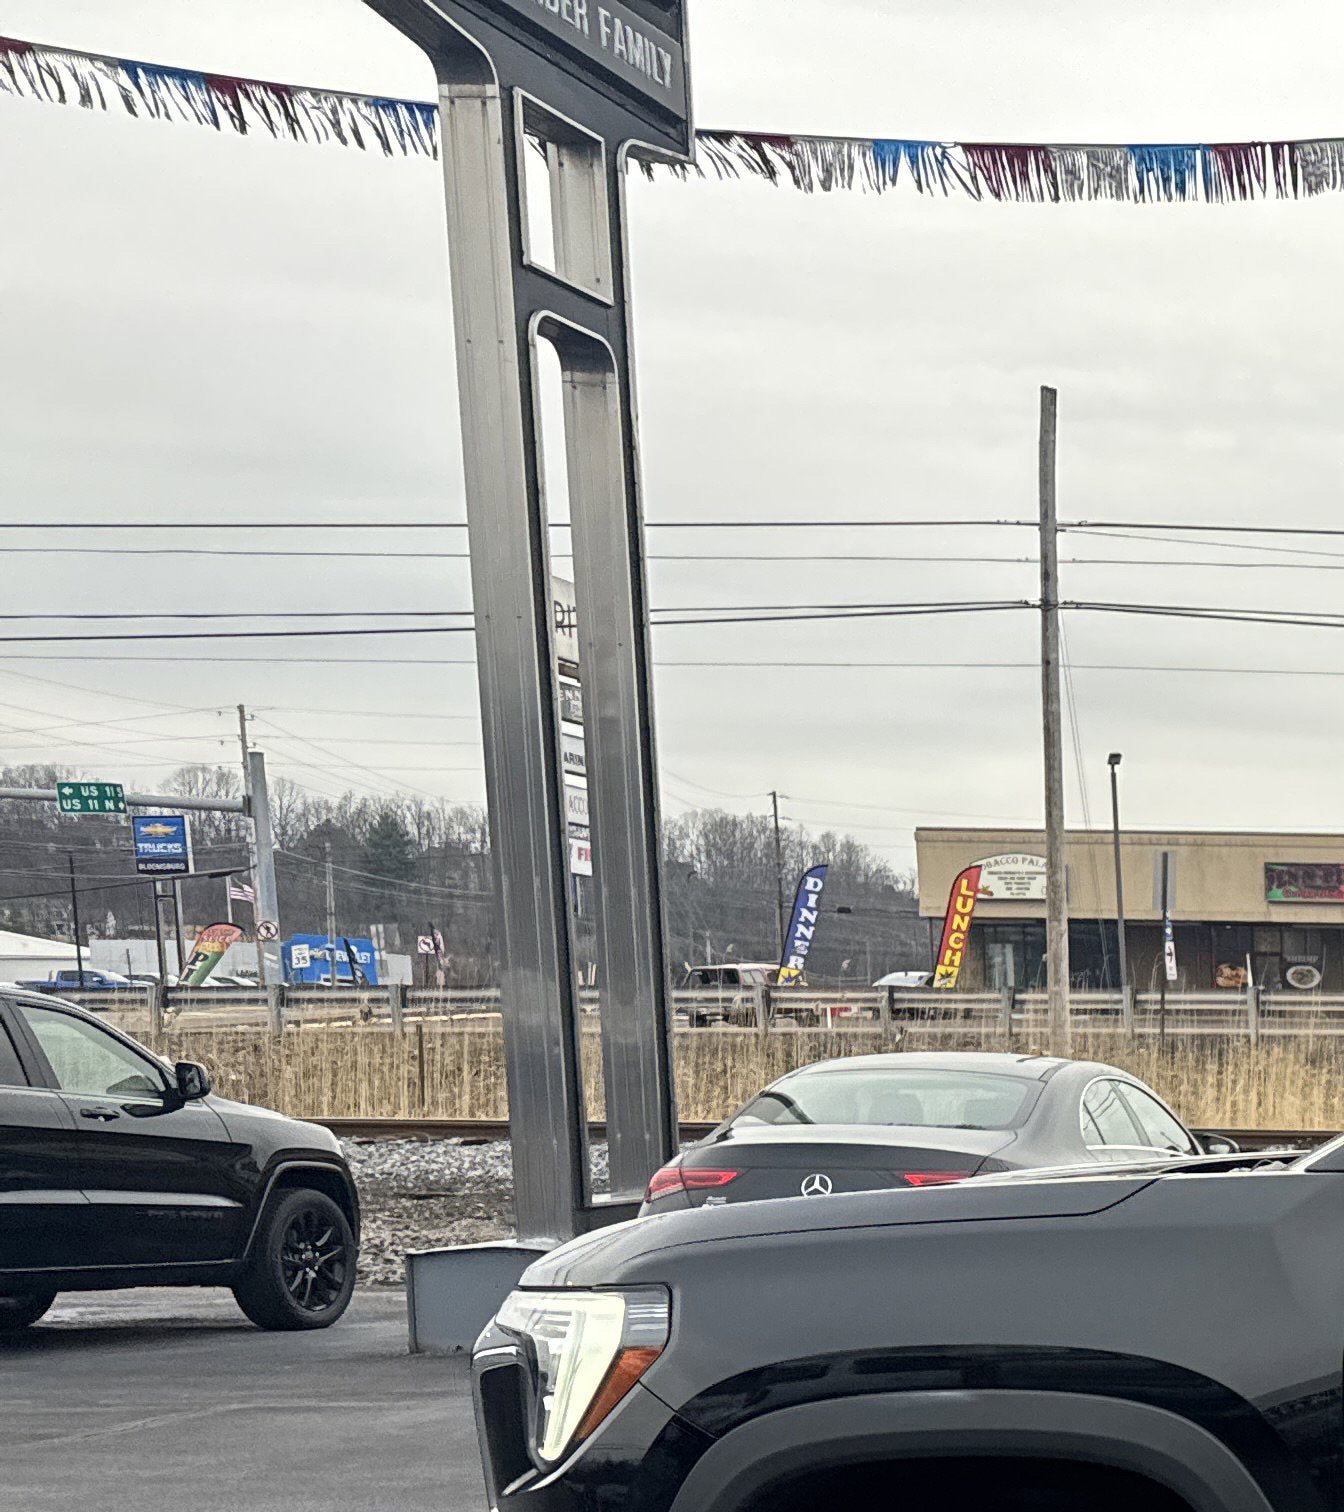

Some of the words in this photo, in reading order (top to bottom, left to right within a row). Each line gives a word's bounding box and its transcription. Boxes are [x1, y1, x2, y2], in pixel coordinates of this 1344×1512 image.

[597, 6, 671, 89] FAMILY
[80, 786, 99, 797] US
[104, 786, 115, 797] 11
[62, 799, 81, 810] US
[88, 799, 99, 810] 11
[105, 799, 115, 810] N
[137, 843, 182, 853] TRUCKS
[983, 857, 1019, 870] BACCO
[1022, 857, 1046, 869] PAL
[788, 877, 823, 970] DINNER
[944, 879, 974, 967] LUNCH
[295, 956, 308, 965] 35
